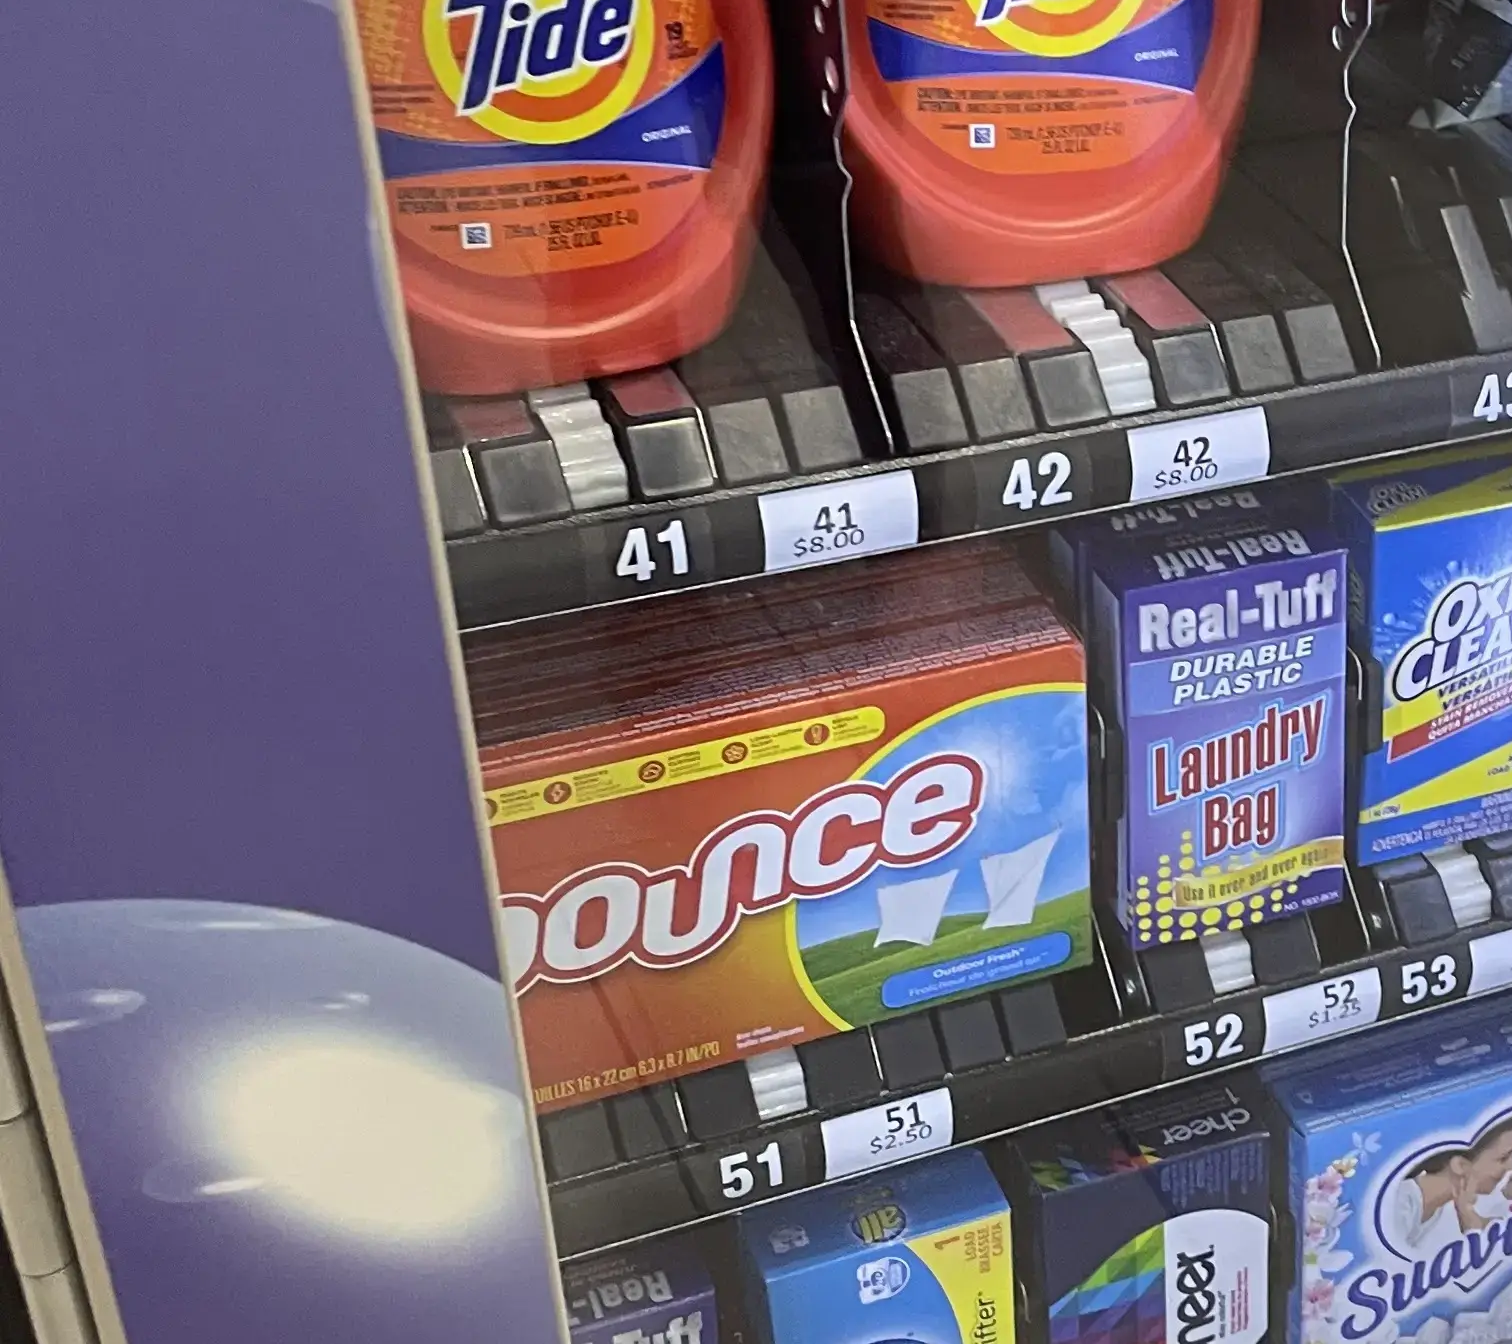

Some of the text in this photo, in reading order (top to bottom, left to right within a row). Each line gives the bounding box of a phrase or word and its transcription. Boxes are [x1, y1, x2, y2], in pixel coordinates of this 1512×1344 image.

[1172, 436, 1213, 468] 42
[1001, 451, 1073, 510] 42
[1152, 461, 1218, 490] $8.00
[813, 501, 857, 533] 41
[615, 518, 690, 582] 41
[792, 526, 865, 557] $8.00
[1138, 568, 1338, 653] Real-Tuff
[1169, 634, 1314, 683] DURABLE
[1172, 662, 1304, 707] PLASTIC
[1152, 694, 1327, 808] Laundry
[1202, 781, 1279, 860] Bag
[1183, 885, 1204, 901] Use
[1219, 878, 1245, 896] over
[1250, 865, 1269, 885] and
[1272, 856, 1298, 876] over
[932, 958, 985, 979] Outdoor
[1401, 955, 1457, 1005] 53
[1308, 1000, 1362, 1028] $1.25
[1322, 979, 1356, 1009] 52
[1183, 1013, 1244, 1066] 52
[577, 1075, 593, 1094] 16
[602, 1068, 617, 1086] 22
[869, 1123, 933, 1155] $2.50
[886, 1102, 927, 1134] 51
[1162, 1107, 1251, 1146] cheer
[720, 1141, 783, 1199] 51
